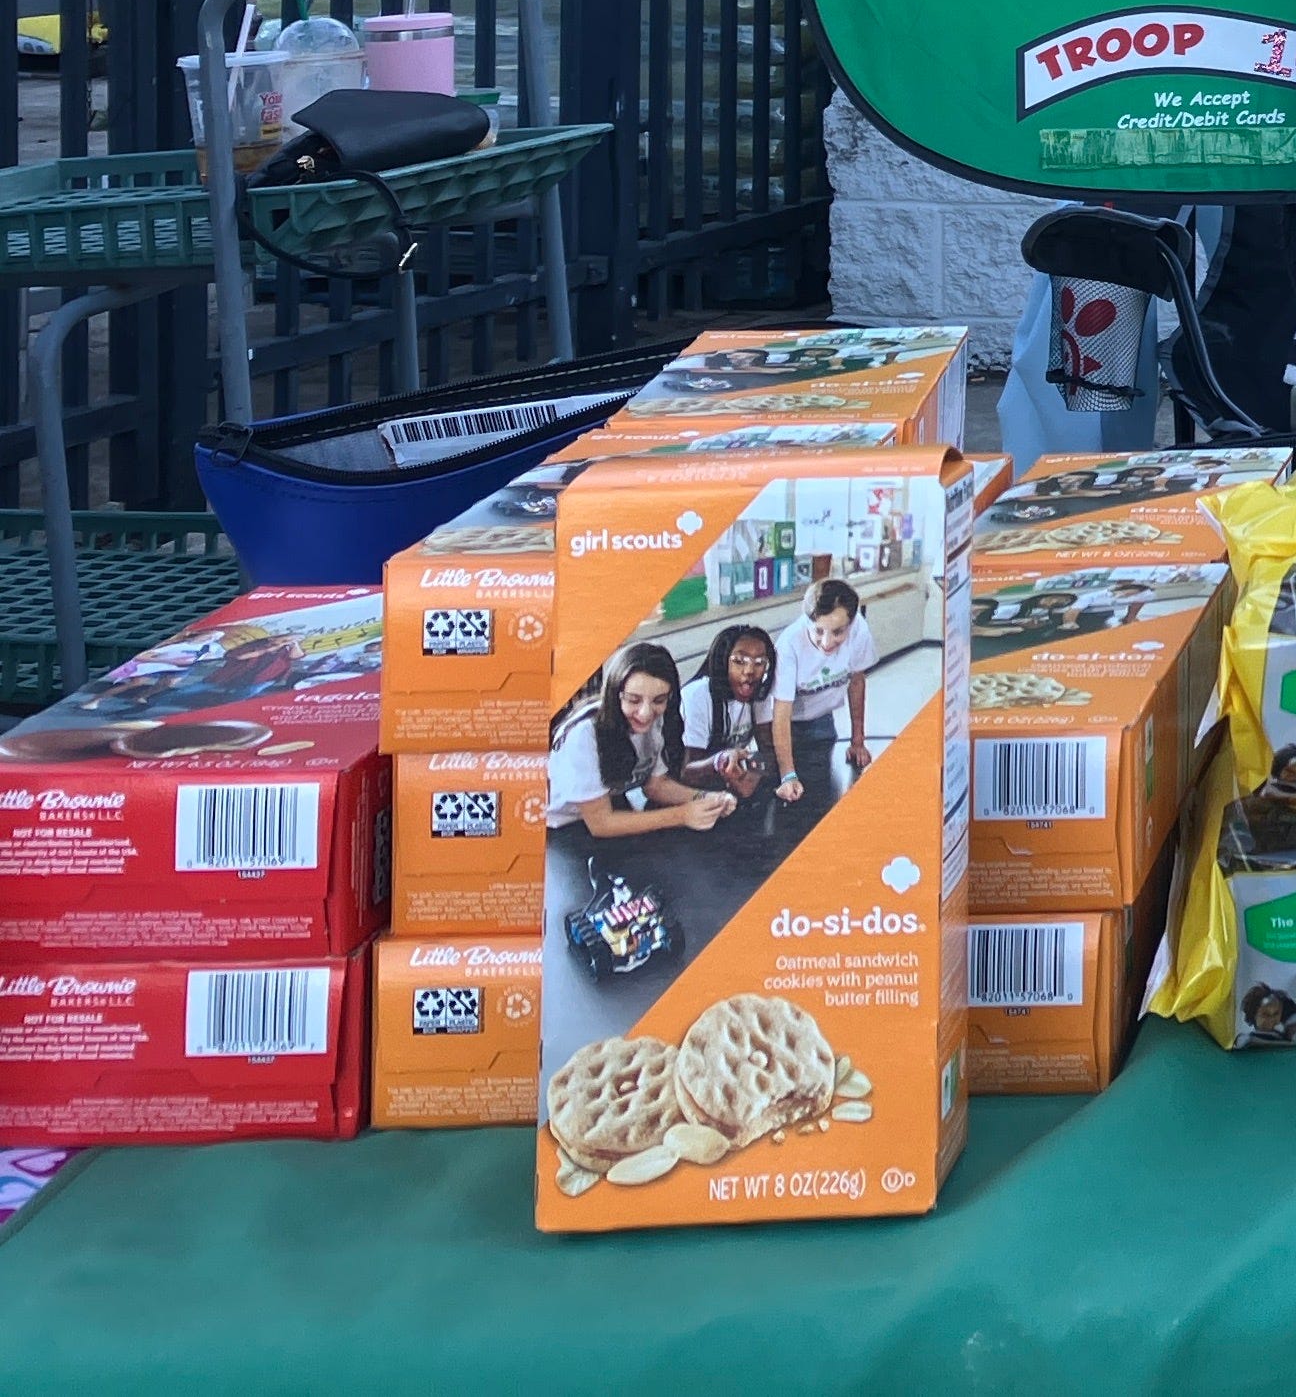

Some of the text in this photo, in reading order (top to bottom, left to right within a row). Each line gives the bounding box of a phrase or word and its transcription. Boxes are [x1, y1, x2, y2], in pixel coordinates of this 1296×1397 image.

[1036, 23, 1205, 81] TROOP
[1154, 90, 1251, 108] We Accept
[1117, 109, 1286, 129] Credit/Debit Cards
[570, 529, 682, 557] girl scouts
[420, 568, 555, 588] Little Browni
[294, 691, 381, 703] tagalo
[428, 753, 479, 771] Little
[37, 789, 126, 811] Brownie
[56, 828, 92, 838] RESALE
[1270, 917, 1294, 928] The
[410, 946, 542, 966] Little Browni
[776, 951, 919, 970] Oatmeal sandwich
[49, 977, 136, 996] Brownie
[764, 972, 918, 990] cookies with peanut
[825, 990, 919, 1007] butter filling
[67, 1014, 103, 1024] RESALE
[709, 1168, 866, 1200] NET WT 8 OZ(226g)
